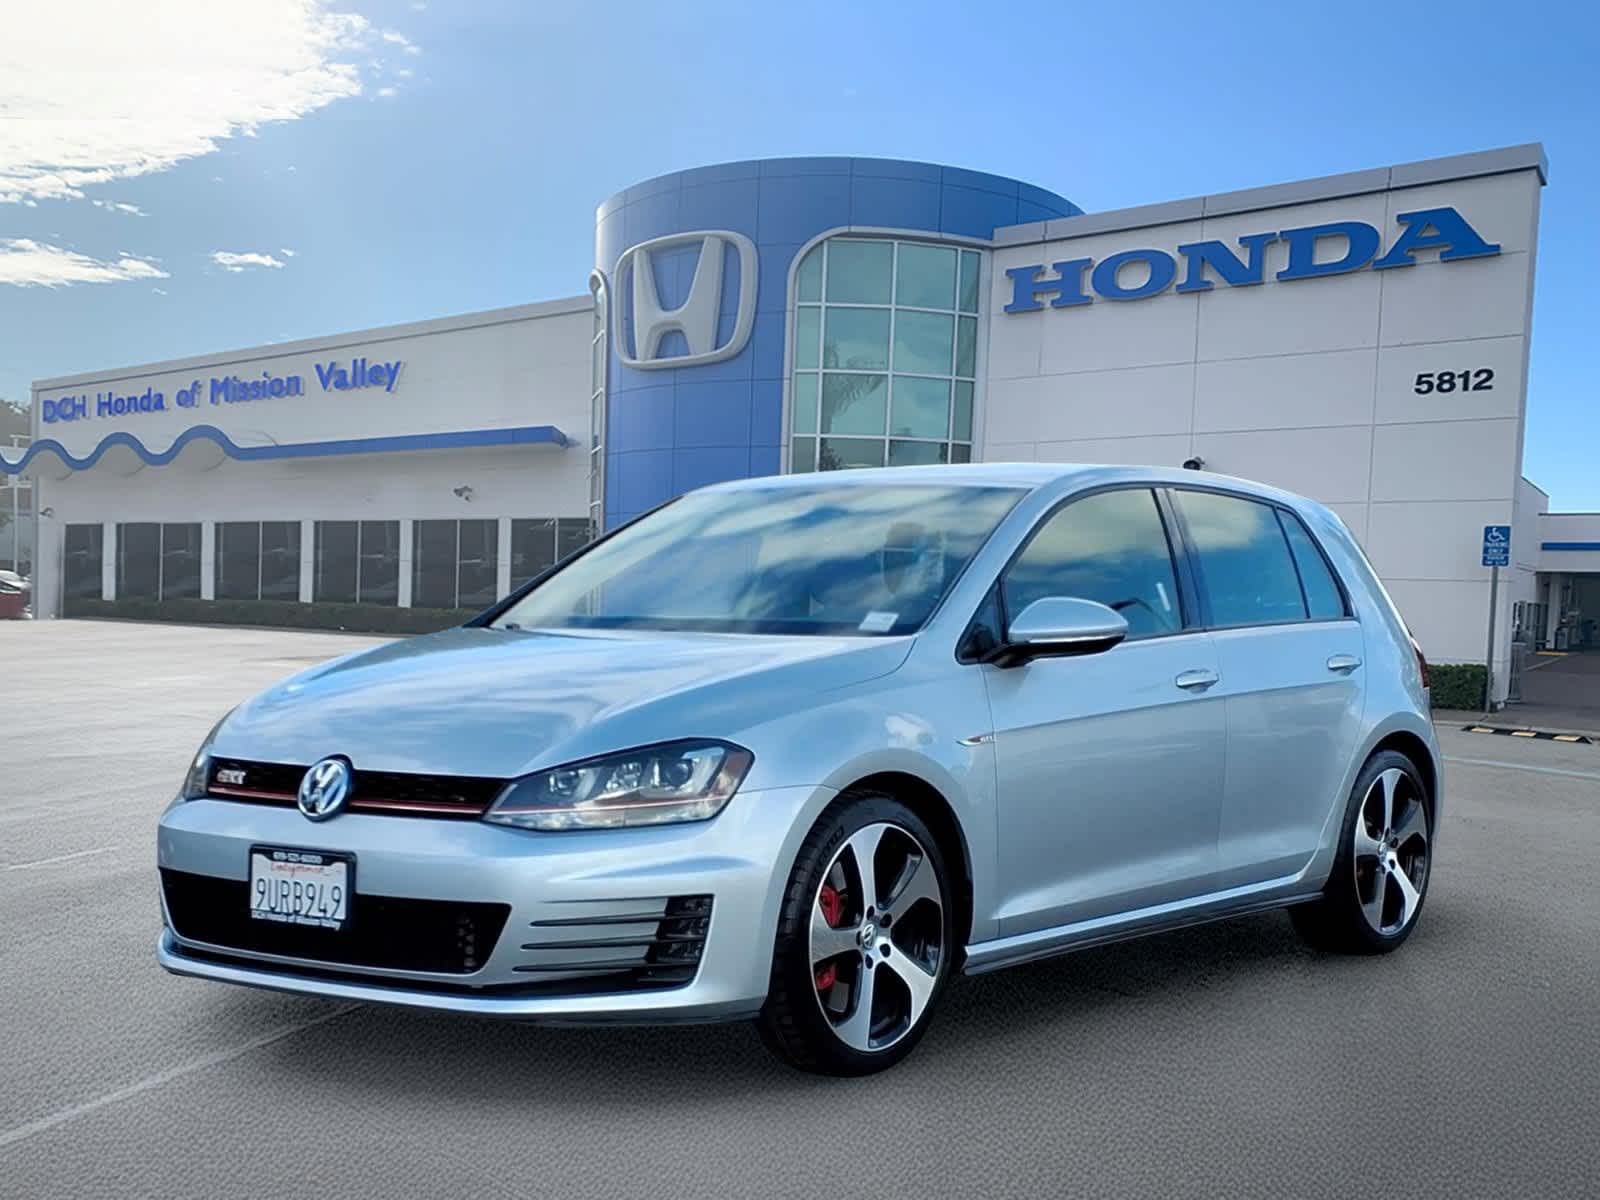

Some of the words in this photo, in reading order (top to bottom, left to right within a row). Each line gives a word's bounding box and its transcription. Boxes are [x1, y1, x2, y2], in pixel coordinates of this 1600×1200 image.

[1003, 207, 1501, 313] HONDA
[42, 395, 87, 424] DCH
[97, 387, 166, 417] Honda
[176, 380, 201, 408] of
[210, 371, 303, 405] Mission
[315, 357, 402, 392] Valley
[1414, 368, 1495, 395] 5812
[255, 877, 342, 922] 9URB949
